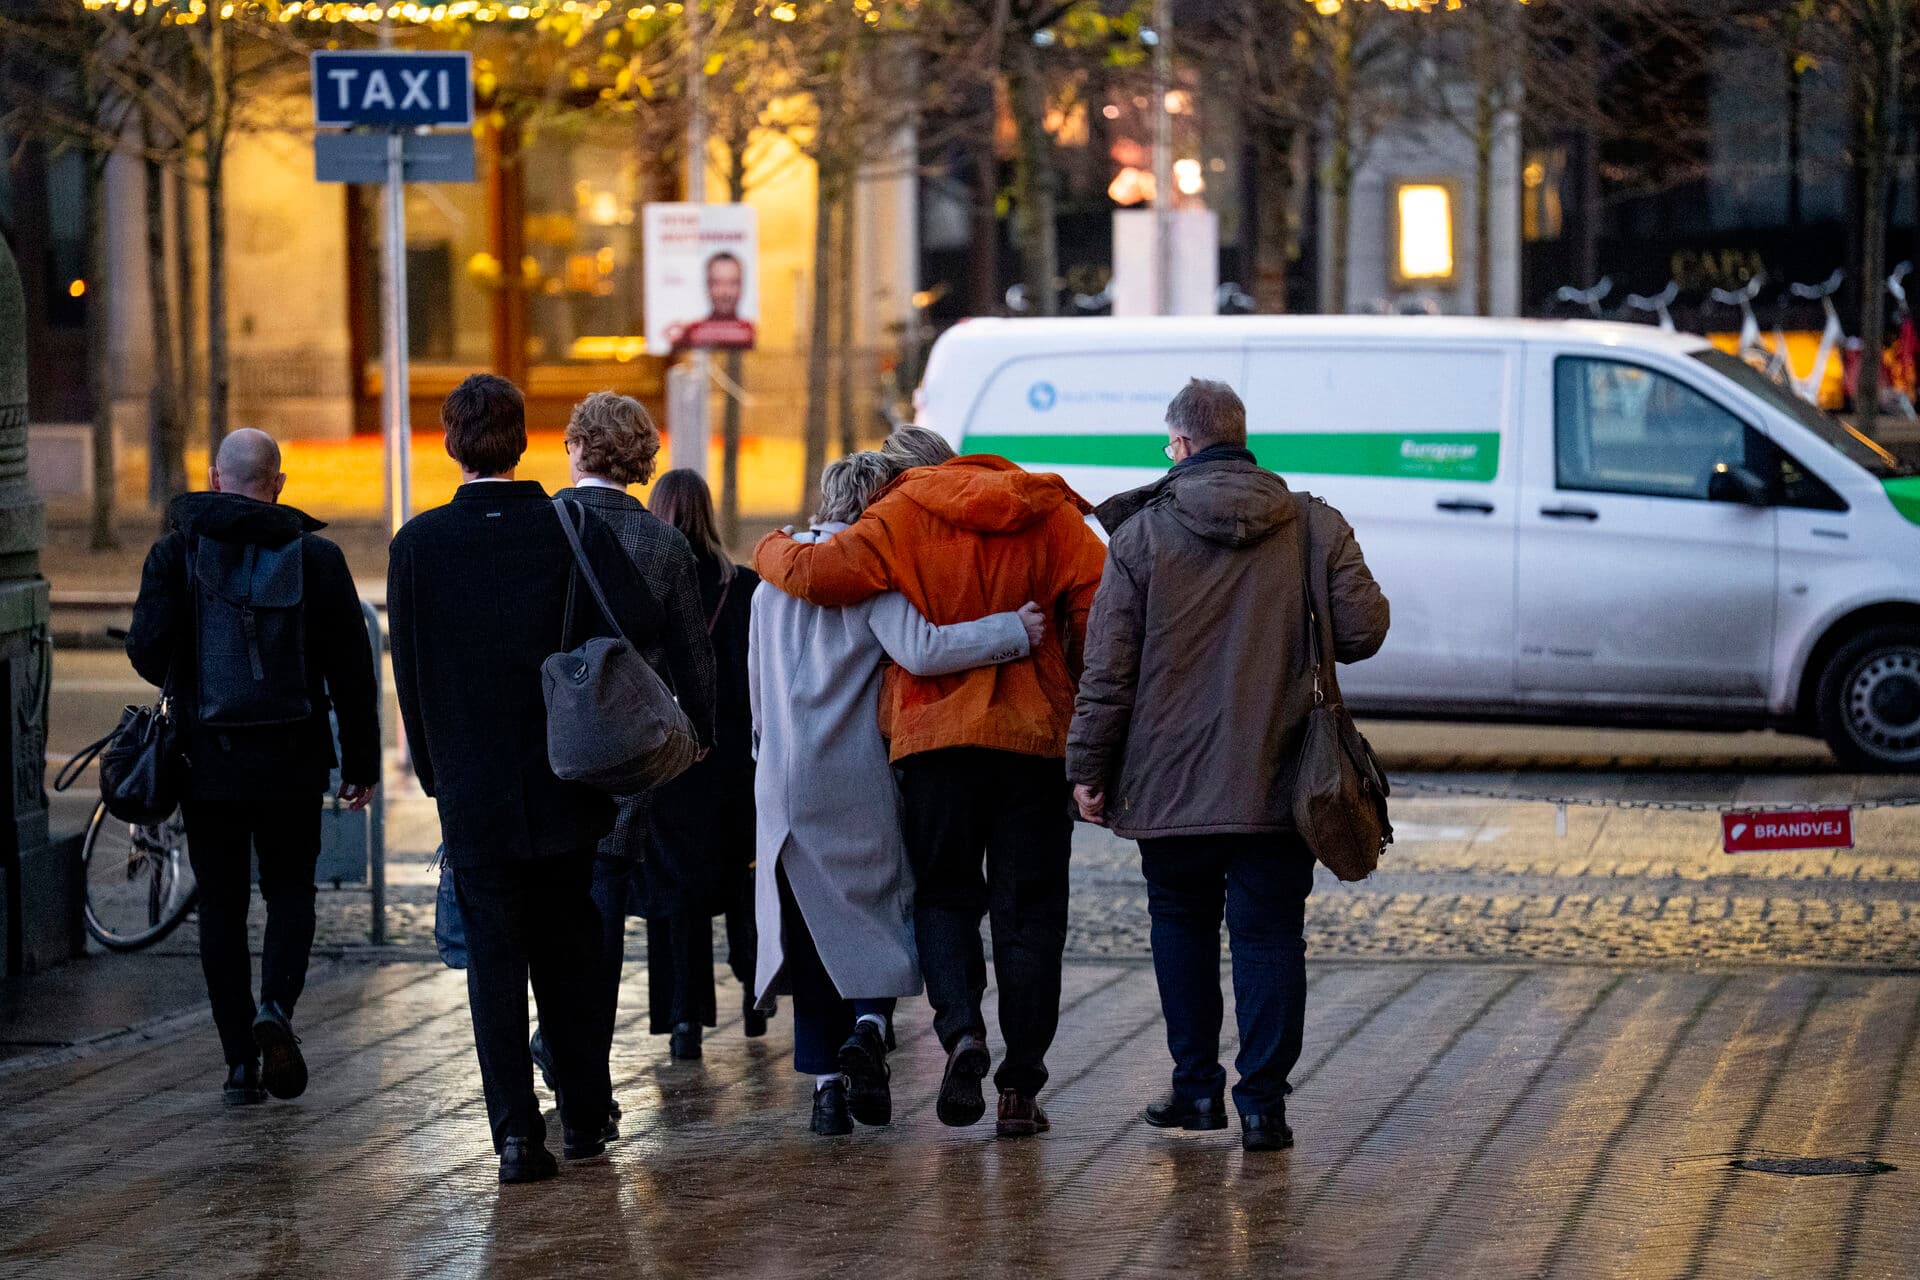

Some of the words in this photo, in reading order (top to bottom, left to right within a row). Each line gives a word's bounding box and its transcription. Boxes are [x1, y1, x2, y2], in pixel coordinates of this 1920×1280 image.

[327, 68, 451, 110] TAXI
[1400, 440, 1478, 461] Europcar
[1754, 821, 1843, 838] BRANDVEJ
